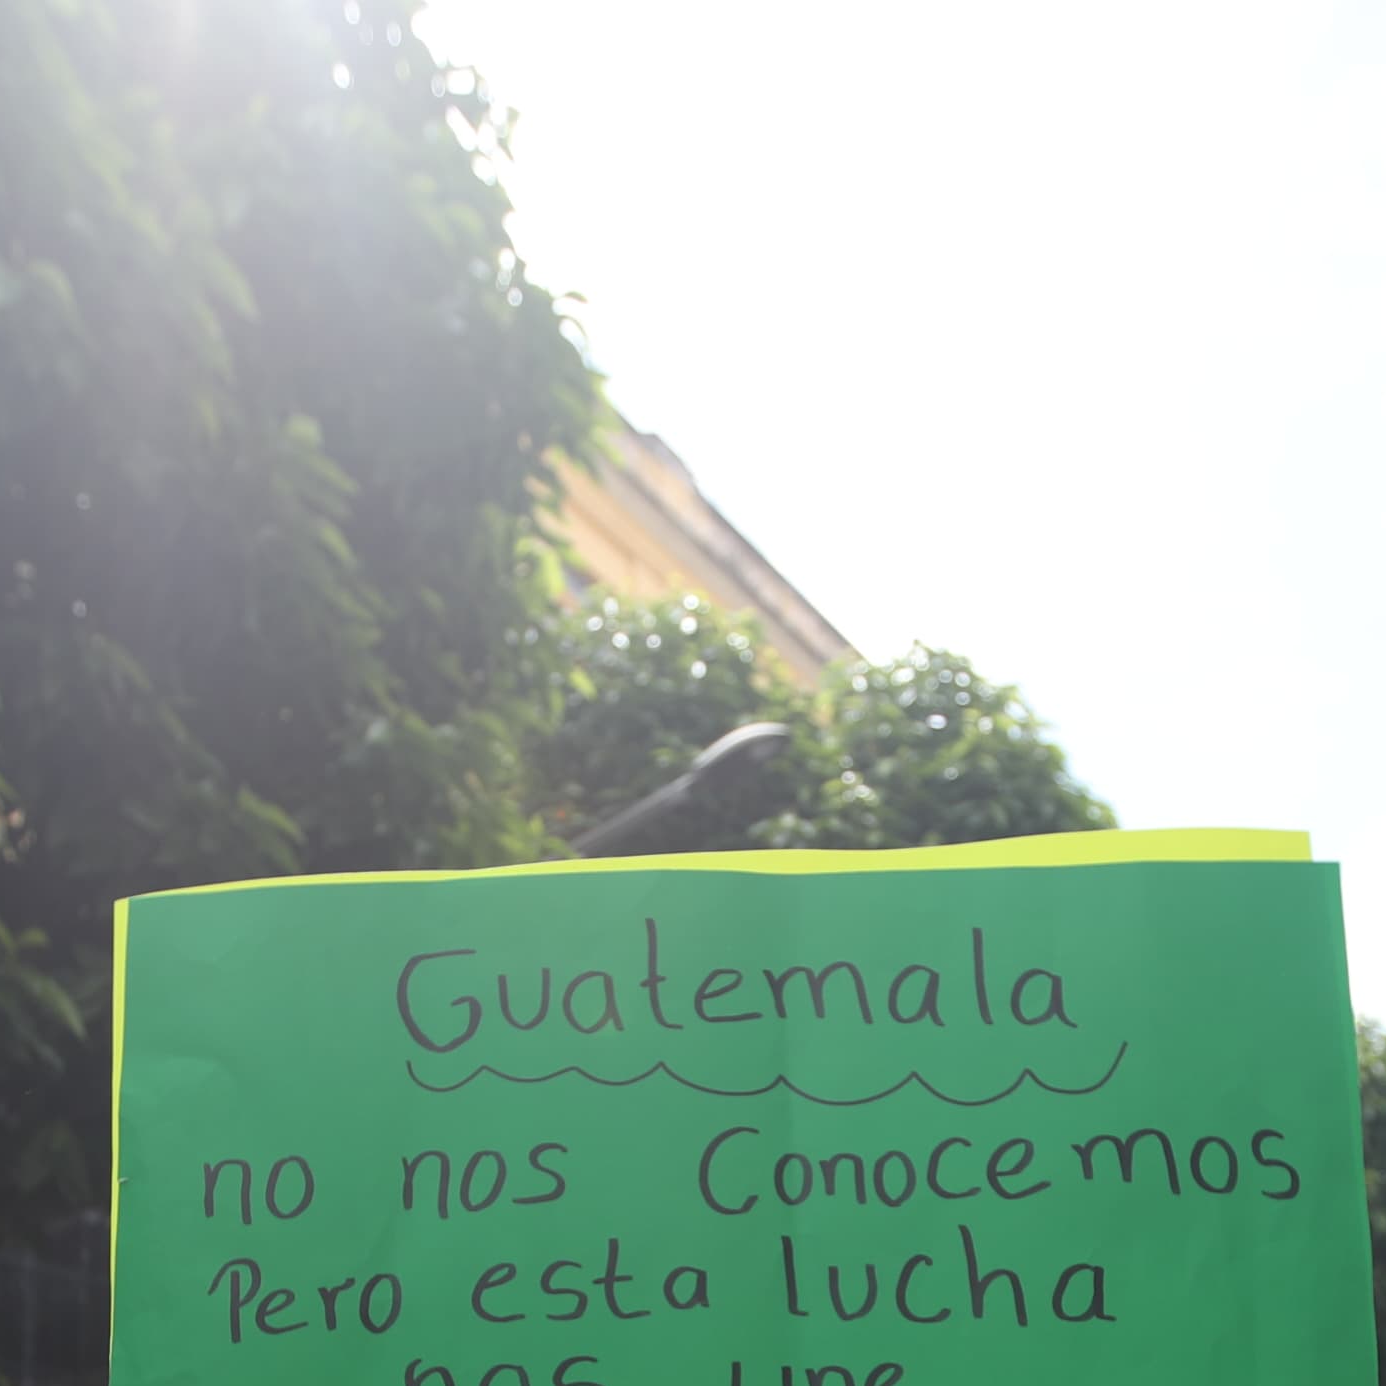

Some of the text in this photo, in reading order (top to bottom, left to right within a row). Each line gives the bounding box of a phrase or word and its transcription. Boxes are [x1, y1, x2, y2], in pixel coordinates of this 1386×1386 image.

[396, 918, 1077, 1053] Guatemala
[203, 1127, 1300, 1225] no nos Conocemos
[208, 1225, 1117, 1343] Pero esta lucha
